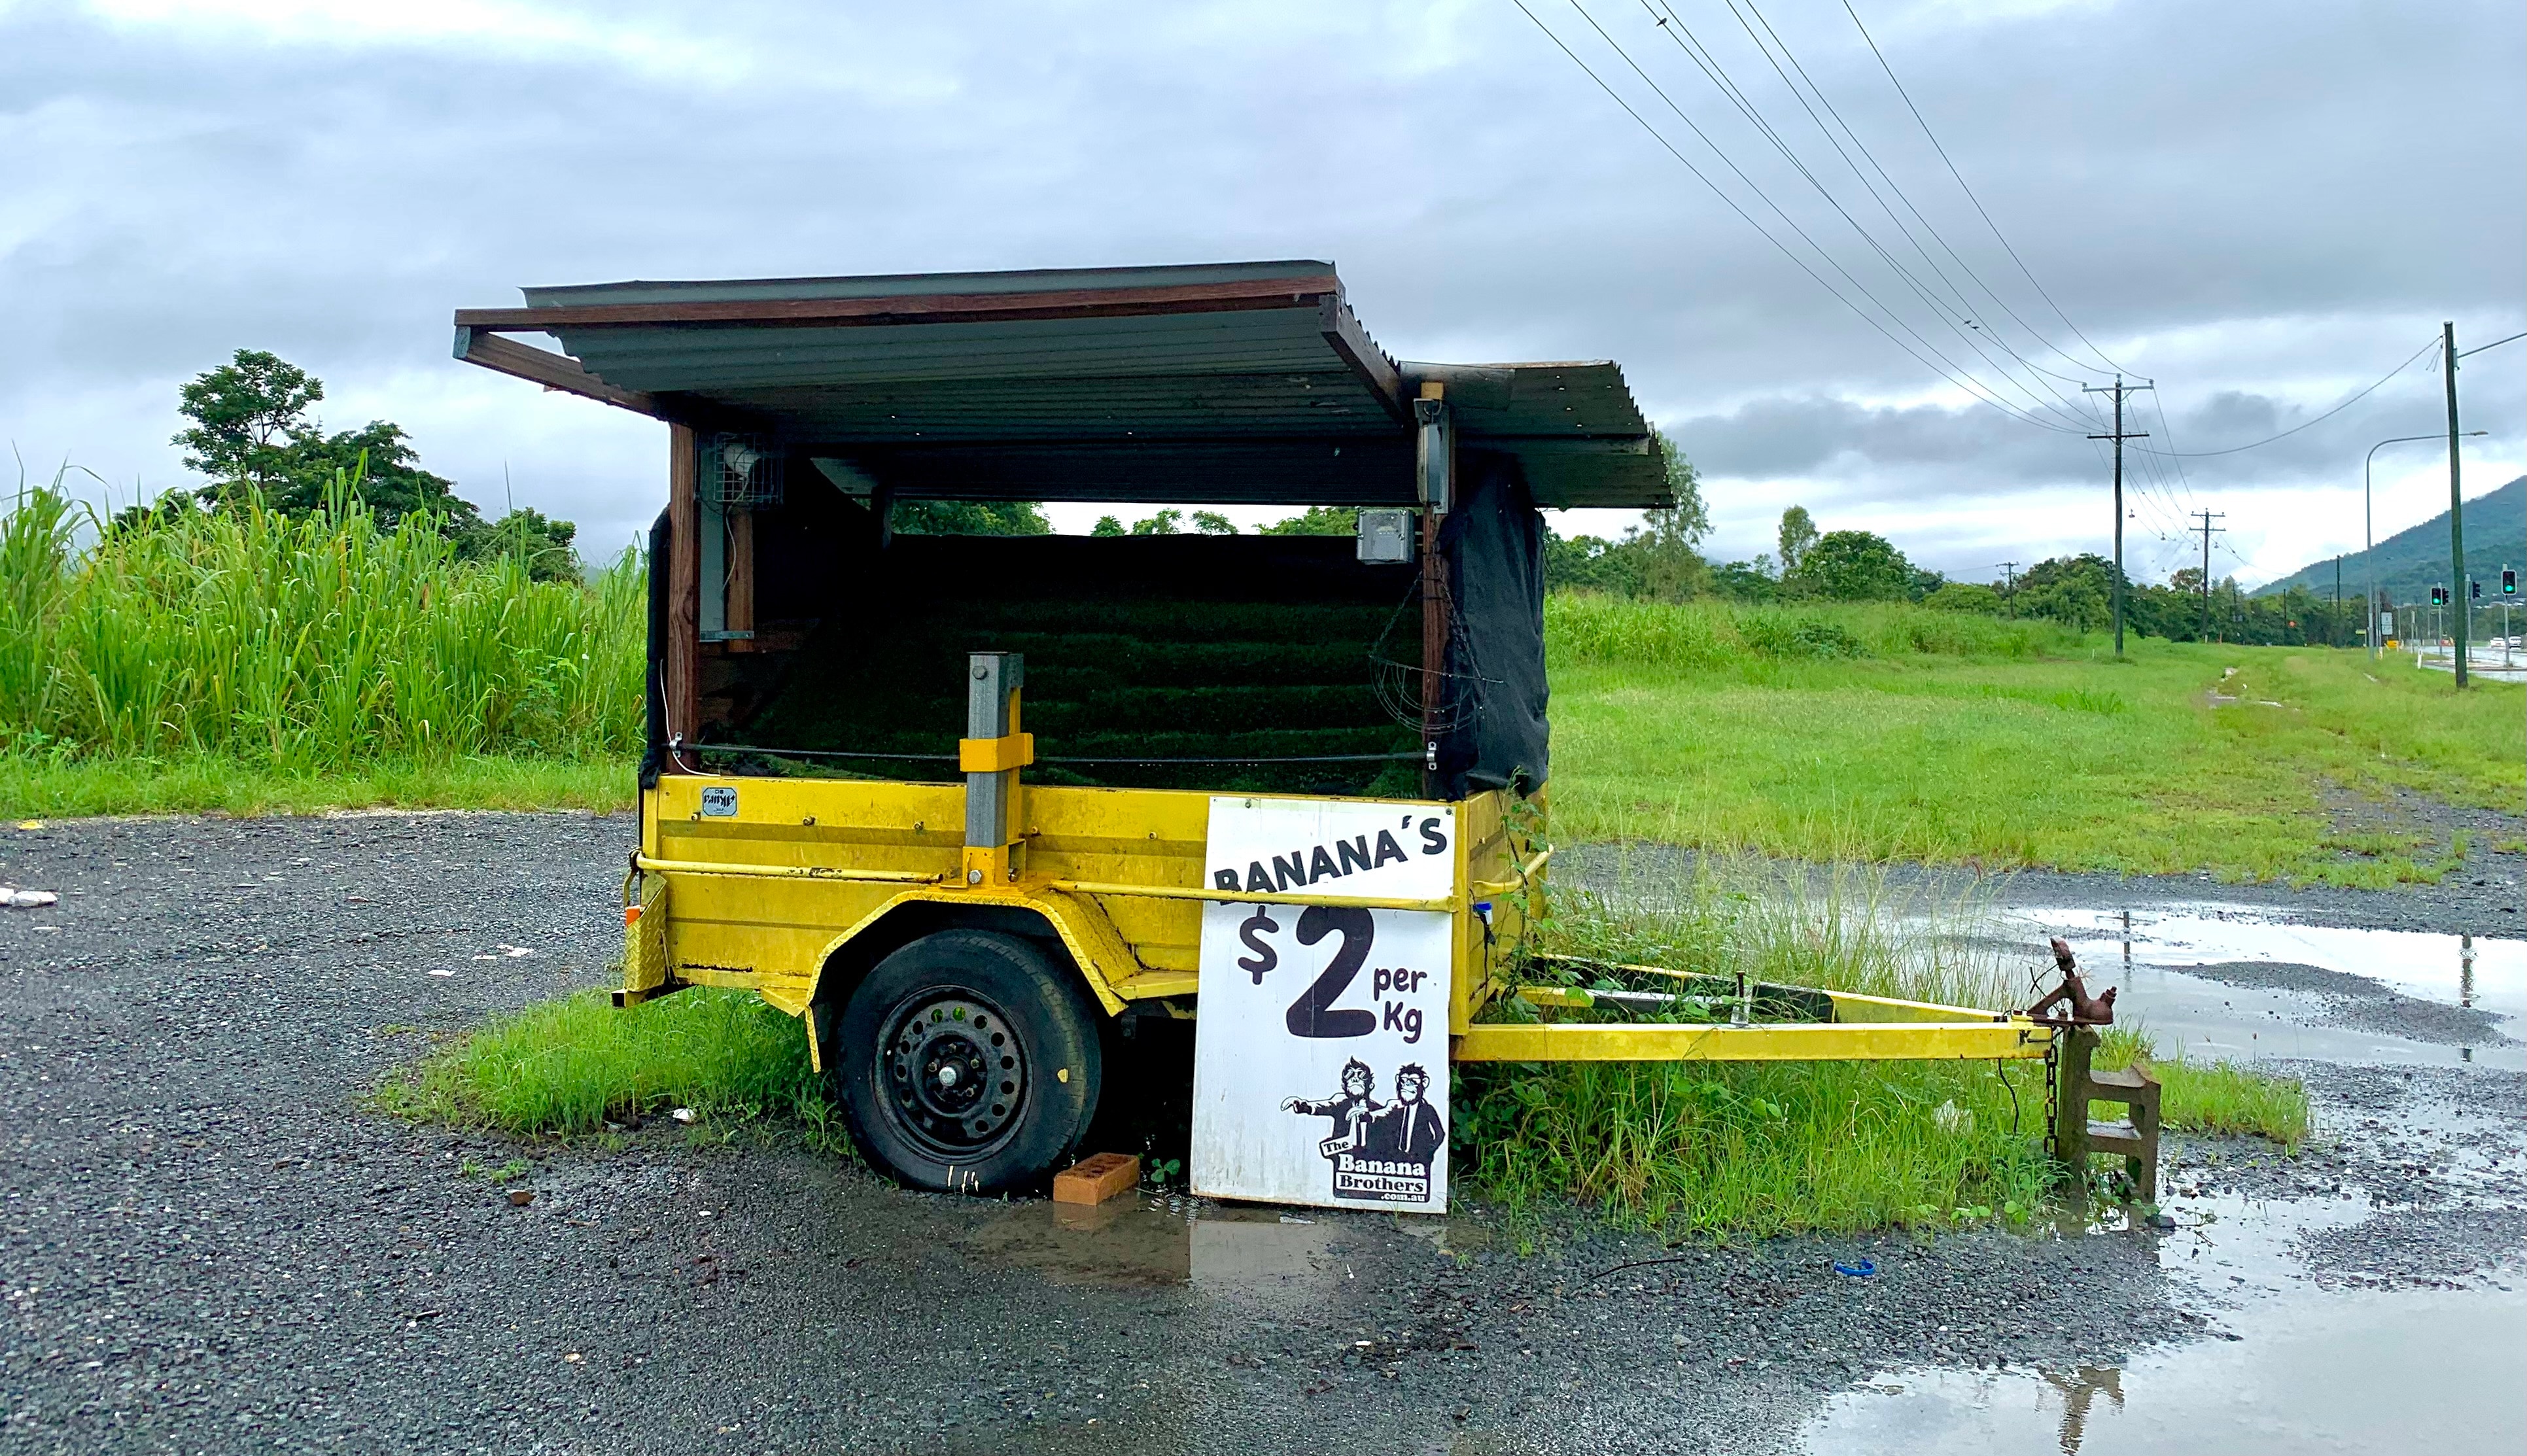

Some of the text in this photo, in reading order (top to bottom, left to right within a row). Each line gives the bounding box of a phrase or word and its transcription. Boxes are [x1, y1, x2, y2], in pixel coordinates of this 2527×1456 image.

[1214, 815, 1448, 907] BANANA'S
[1374, 967, 1427, 1001] per
[1384, 1001, 1423, 1044] Kg
[1323, 1141, 1350, 1153] The
[1338, 1153, 1425, 1176] Banana
[1340, 1174, 1424, 1192] Brothers
[1380, 1192, 1425, 1202] .com.au
